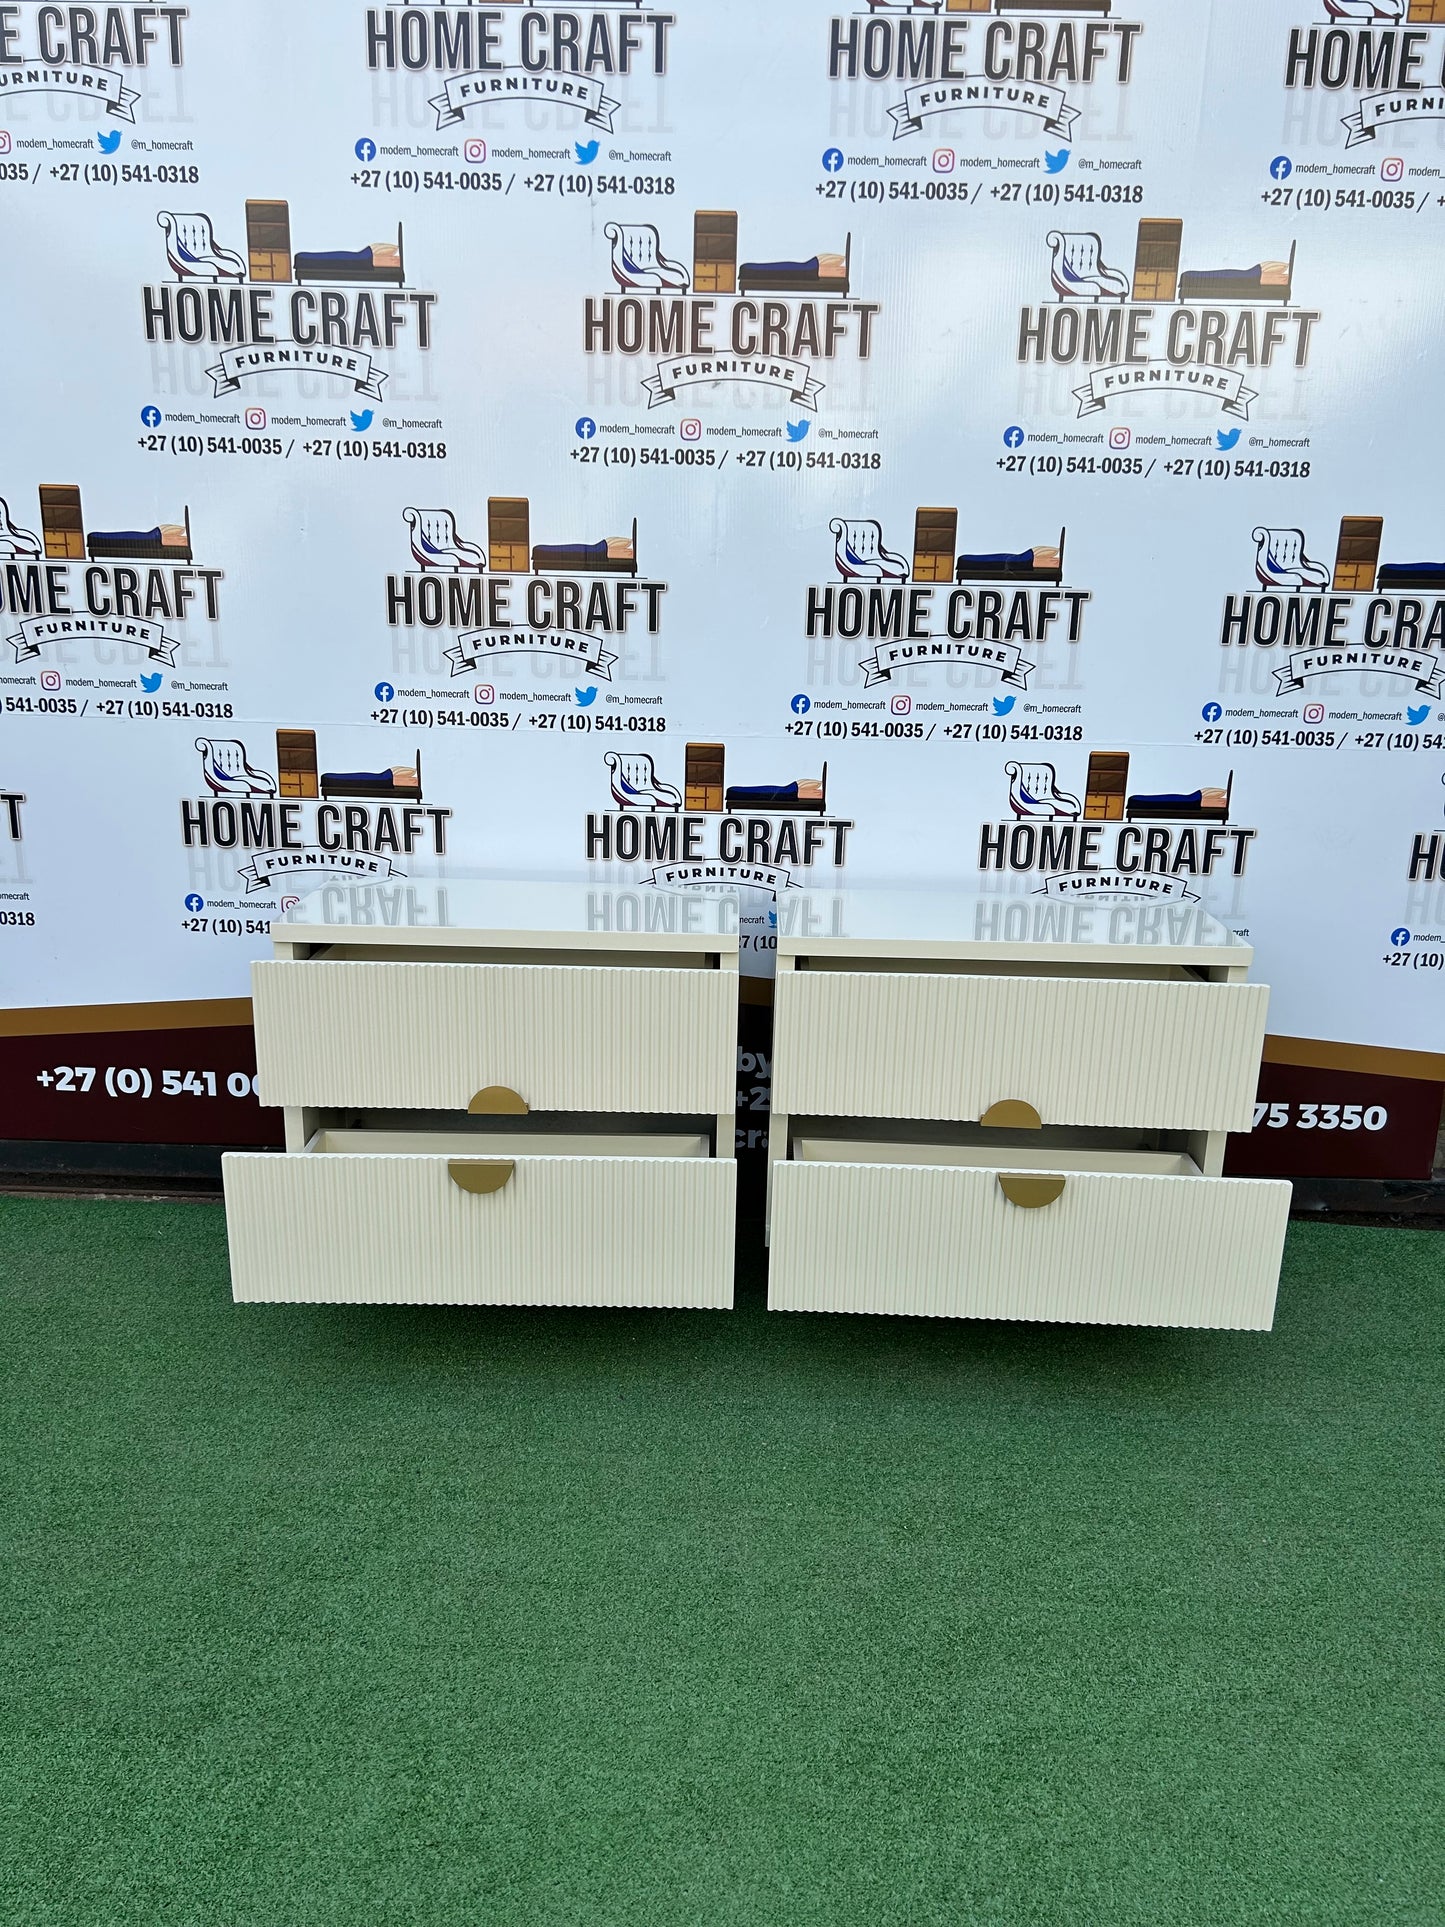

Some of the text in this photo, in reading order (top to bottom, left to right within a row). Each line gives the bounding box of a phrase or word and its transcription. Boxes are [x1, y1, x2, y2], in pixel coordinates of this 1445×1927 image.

[38, 6, 187, 65] CRAFT
[366, 10, 673, 73] HOME CRAFT
[829, 18, 1141, 82] HOME CRAFT
[1285, 28, 1427, 89] HOME
[0, 70, 108, 91] URNITURE
[460, 77, 588, 100] FURNITURE
[921, 86, 1050, 108] FURNITURE
[1375, 97, 1445, 117] FURNI
[131, 140, 193, 151] @m_homecraft
[608, 150, 672, 163] @m_homecraft
[50, 164, 79, 181] +27
[84, 164, 118, 185] (10)
[121, 165, 199, 183] 541-0318
[1078, 158, 1142, 171] @m_homecraft
[350, 170, 381, 188] +27
[385, 171, 420, 193] (10)
[523, 174, 555, 192] +27
[558, 175, 593, 197] (10)
[596, 175, 675, 195] 541-0318
[815, 181, 847, 199] +27
[850, 181, 885, 203] (10)
[990, 183, 1022, 202] +27
[1025, 184, 1060, 206] (10)
[1063, 185, 1144, 204] 541-0318
[1261, 188, 1293, 206] +27
[1296, 189, 1332, 210] (10)
[143, 286, 436, 348] HOME CRAFT
[584, 298, 878, 358] HOME CRAFT
[1017, 307, 1318, 366] HOME CRAFT
[236, 350, 357, 371] FURNITURE
[673, 360, 795, 381] FURNITURE
[1105, 369, 1228, 390] FURNITURE
[382, 418, 443, 430] @m_homecraft
[818, 428, 878, 440] @m_homecraft
[138, 435, 167, 451] +27
[171, 435, 203, 456] (10)
[303, 439, 332, 457] +27
[336, 440, 369, 461] (10)
[372, 440, 447, 459] 541-0318
[1248, 436, 1310, 448] @m_homecraft
[570, 447, 599, 463] +27
[603, 447, 636, 467] (10)
[736, 450, 766, 467] +27
[769, 451, 802, 471] (10)
[805, 451, 881, 469] 541-0318
[996, 455, 1026, 472] +27
[1029, 456, 1063, 476] (10)
[1163, 458, 1194, 475] +27
[1198, 459, 1231, 479] (10)
[1234, 460, 1310, 478] 541-0318
[0, 564, 222, 619] ME CRAFT
[387, 575, 666, 632] HOME CRAFT
[806, 587, 1089, 641] HOME CRAFT
[34, 620, 150, 640] FURNITURE
[1221, 596, 1445, 649] HOME CRA
[472, 633, 589, 653] FURNITURE
[889, 643, 1006, 662] FURNITURE
[1303, 653, 1423, 671] FURNITURE
[171, 681, 228, 691] @m_homecraft
[96, 700, 124, 715] +27
[128, 701, 159, 719] (10)
[162, 701, 233, 718] 541-0318
[605, 694, 663, 705] @m_homecraft
[1023, 703, 1081, 714] @m_homecraft
[370, 709, 398, 724] +27
[402, 710, 433, 728] (10)
[528, 714, 557, 729] +27
[560, 715, 592, 732] (10)
[595, 715, 666, 732] 541-0318
[784, 720, 813, 736] +27
[816, 721, 848, 739] (10)
[943, 723, 972, 739] +27
[975, 724, 1007, 742] (10)
[1010, 725, 1083, 740] 541-0318
[1194, 729, 1223, 744] +27
[1226, 729, 1258, 747] (10)
[1355, 733, 1384, 748] +27
[1387, 733, 1419, 751] (10)
[181, 800, 450, 853] HOME CRAFT
[587, 814, 851, 865] HOME CRAFT
[979, 824, 1254, 875] HOME CRAFT
[266, 854, 378, 872] FURNITURE
[666, 867, 777, 884] FURNITURE
[1059, 876, 1173, 894] FURNITURE
[0, 911, 35, 926] 0318
[181, 918, 270, 936] +27 (10) 541
[1382, 952, 1444, 970] +27 (10)
[36, 1066, 96, 1091] +27
[105, 1067, 153, 1098] (0)
[161, 1070, 217, 1096] 541
[1296, 1103, 1387, 1131] 3350
